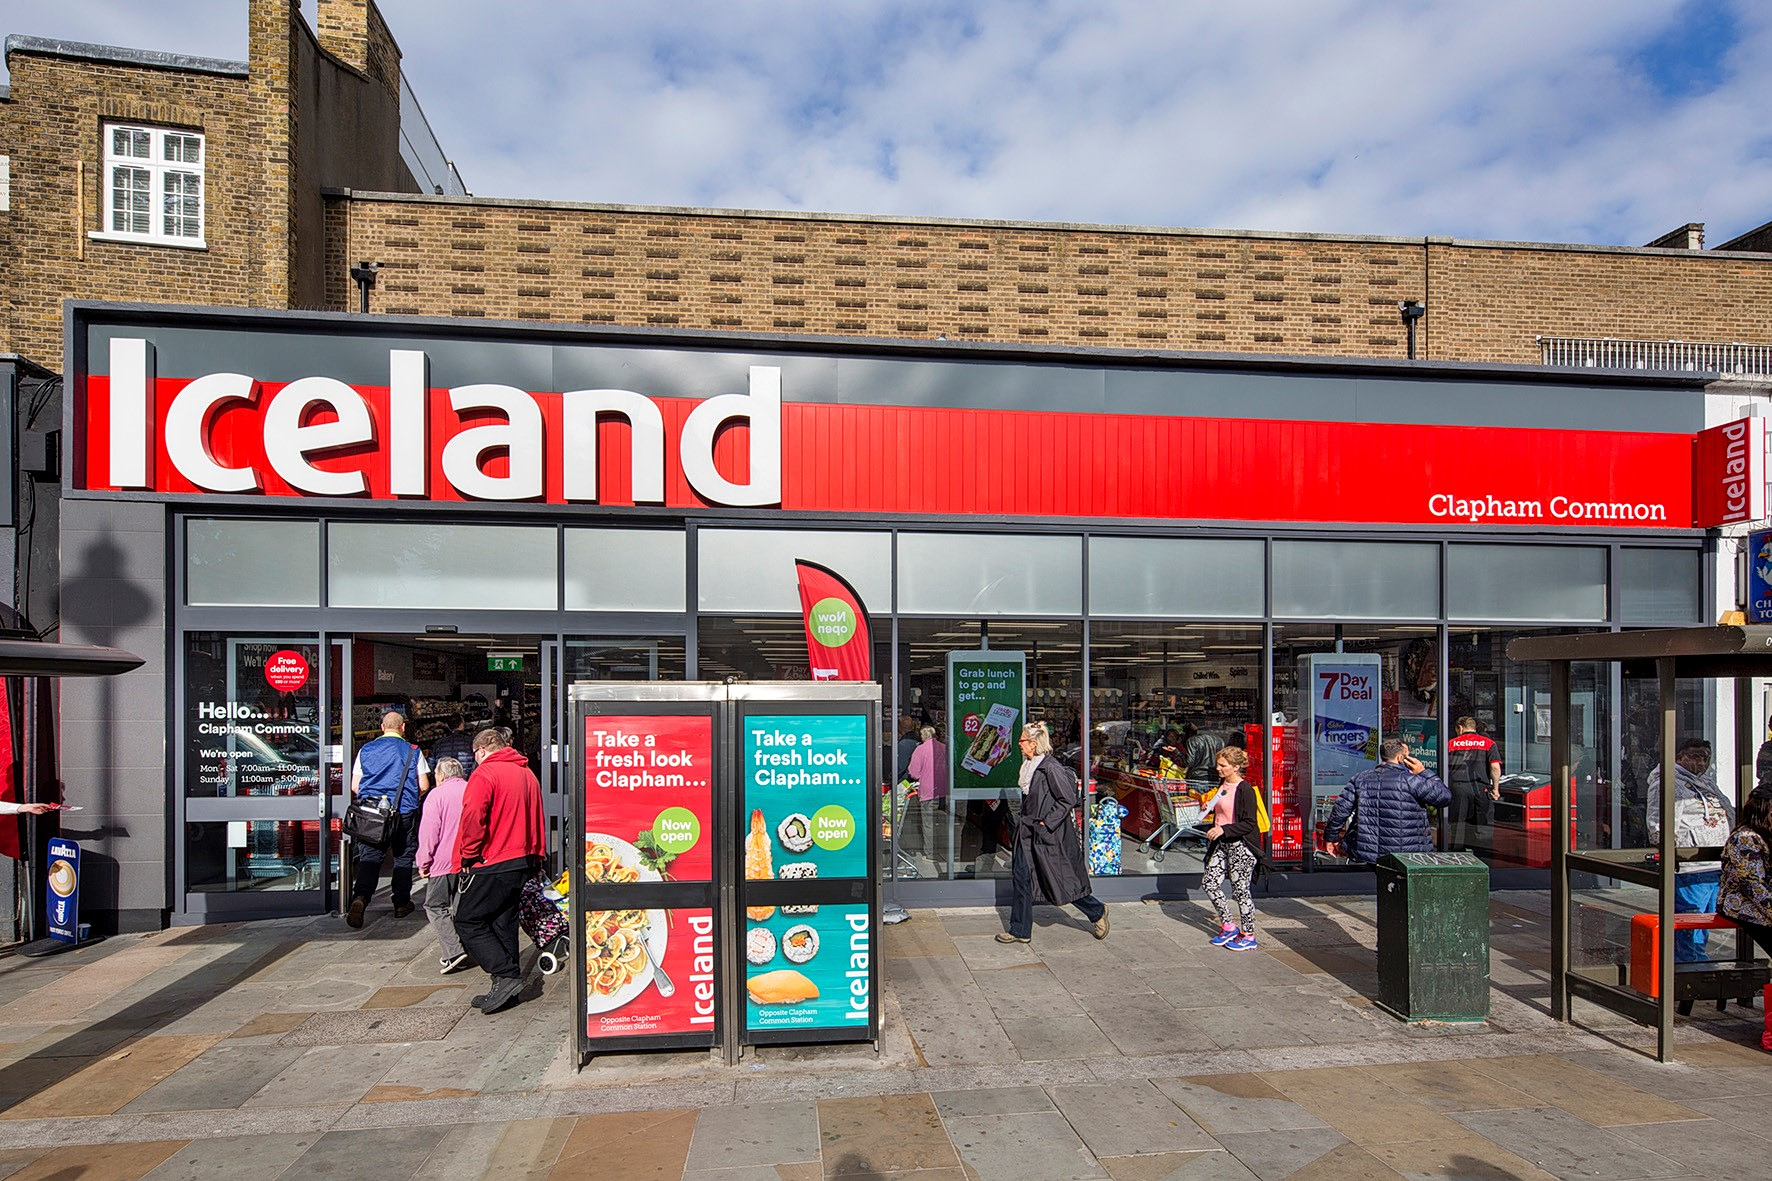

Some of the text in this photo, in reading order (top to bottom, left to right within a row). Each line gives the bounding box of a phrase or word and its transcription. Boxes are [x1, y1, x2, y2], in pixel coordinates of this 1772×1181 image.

[110, 338, 782, 506] Iceland
[1722, 422, 1746, 520] Iceland
[1428, 493, 1667, 522] Clapham Common
[277, 657, 297, 666] Free
[269, 665, 305, 675] delivery
[959, 668, 1015, 678] Grab lunch
[959, 680, 1006, 692] to go and
[1319, 672, 1369, 700] 7 Day
[958, 692, 986, 702] get...
[1340, 686, 1373, 700] Deal
[198, 701, 270, 719] Hello...
[198, 722, 310, 737] Clapham Common
[964, 720, 979, 732] £2
[593, 730, 656, 748] Take a
[752, 730, 813, 747] Take a
[1324, 728, 1366, 745] fingers
[200, 749, 253, 760] We're open
[754, 748, 849, 766] fresh look
[1408, 744, 1437, 757] lapham
[595, 750, 693, 768] fresh look
[200, 764, 218, 773] Mon
[226, 764, 238, 773] Sat
[241, 764, 271, 773] 7:00am
[277, 764, 311, 774] 11:00pm
[200, 775, 230, 785] Sunday
[241, 774, 274, 784] 11:00am
[596, 770, 707, 791] Clapham...
[754, 769, 861, 789] Clapham...
[661, 818, 692, 831] Now
[818, 816, 848, 829] Now
[660, 832, 693, 844] open
[817, 829, 849, 841] open
[51, 844, 76, 858] LAVAZZA
[688, 916, 714, 1024] Iceland
[846, 913, 870, 1020] Iceland
[600, 1014, 662, 1026] Opposite Clapham
[759, 1008, 818, 1019] Opposite Clapham
[600, 1022, 657, 1032] Common Station
[759, 1016, 814, 1025] Common Station
